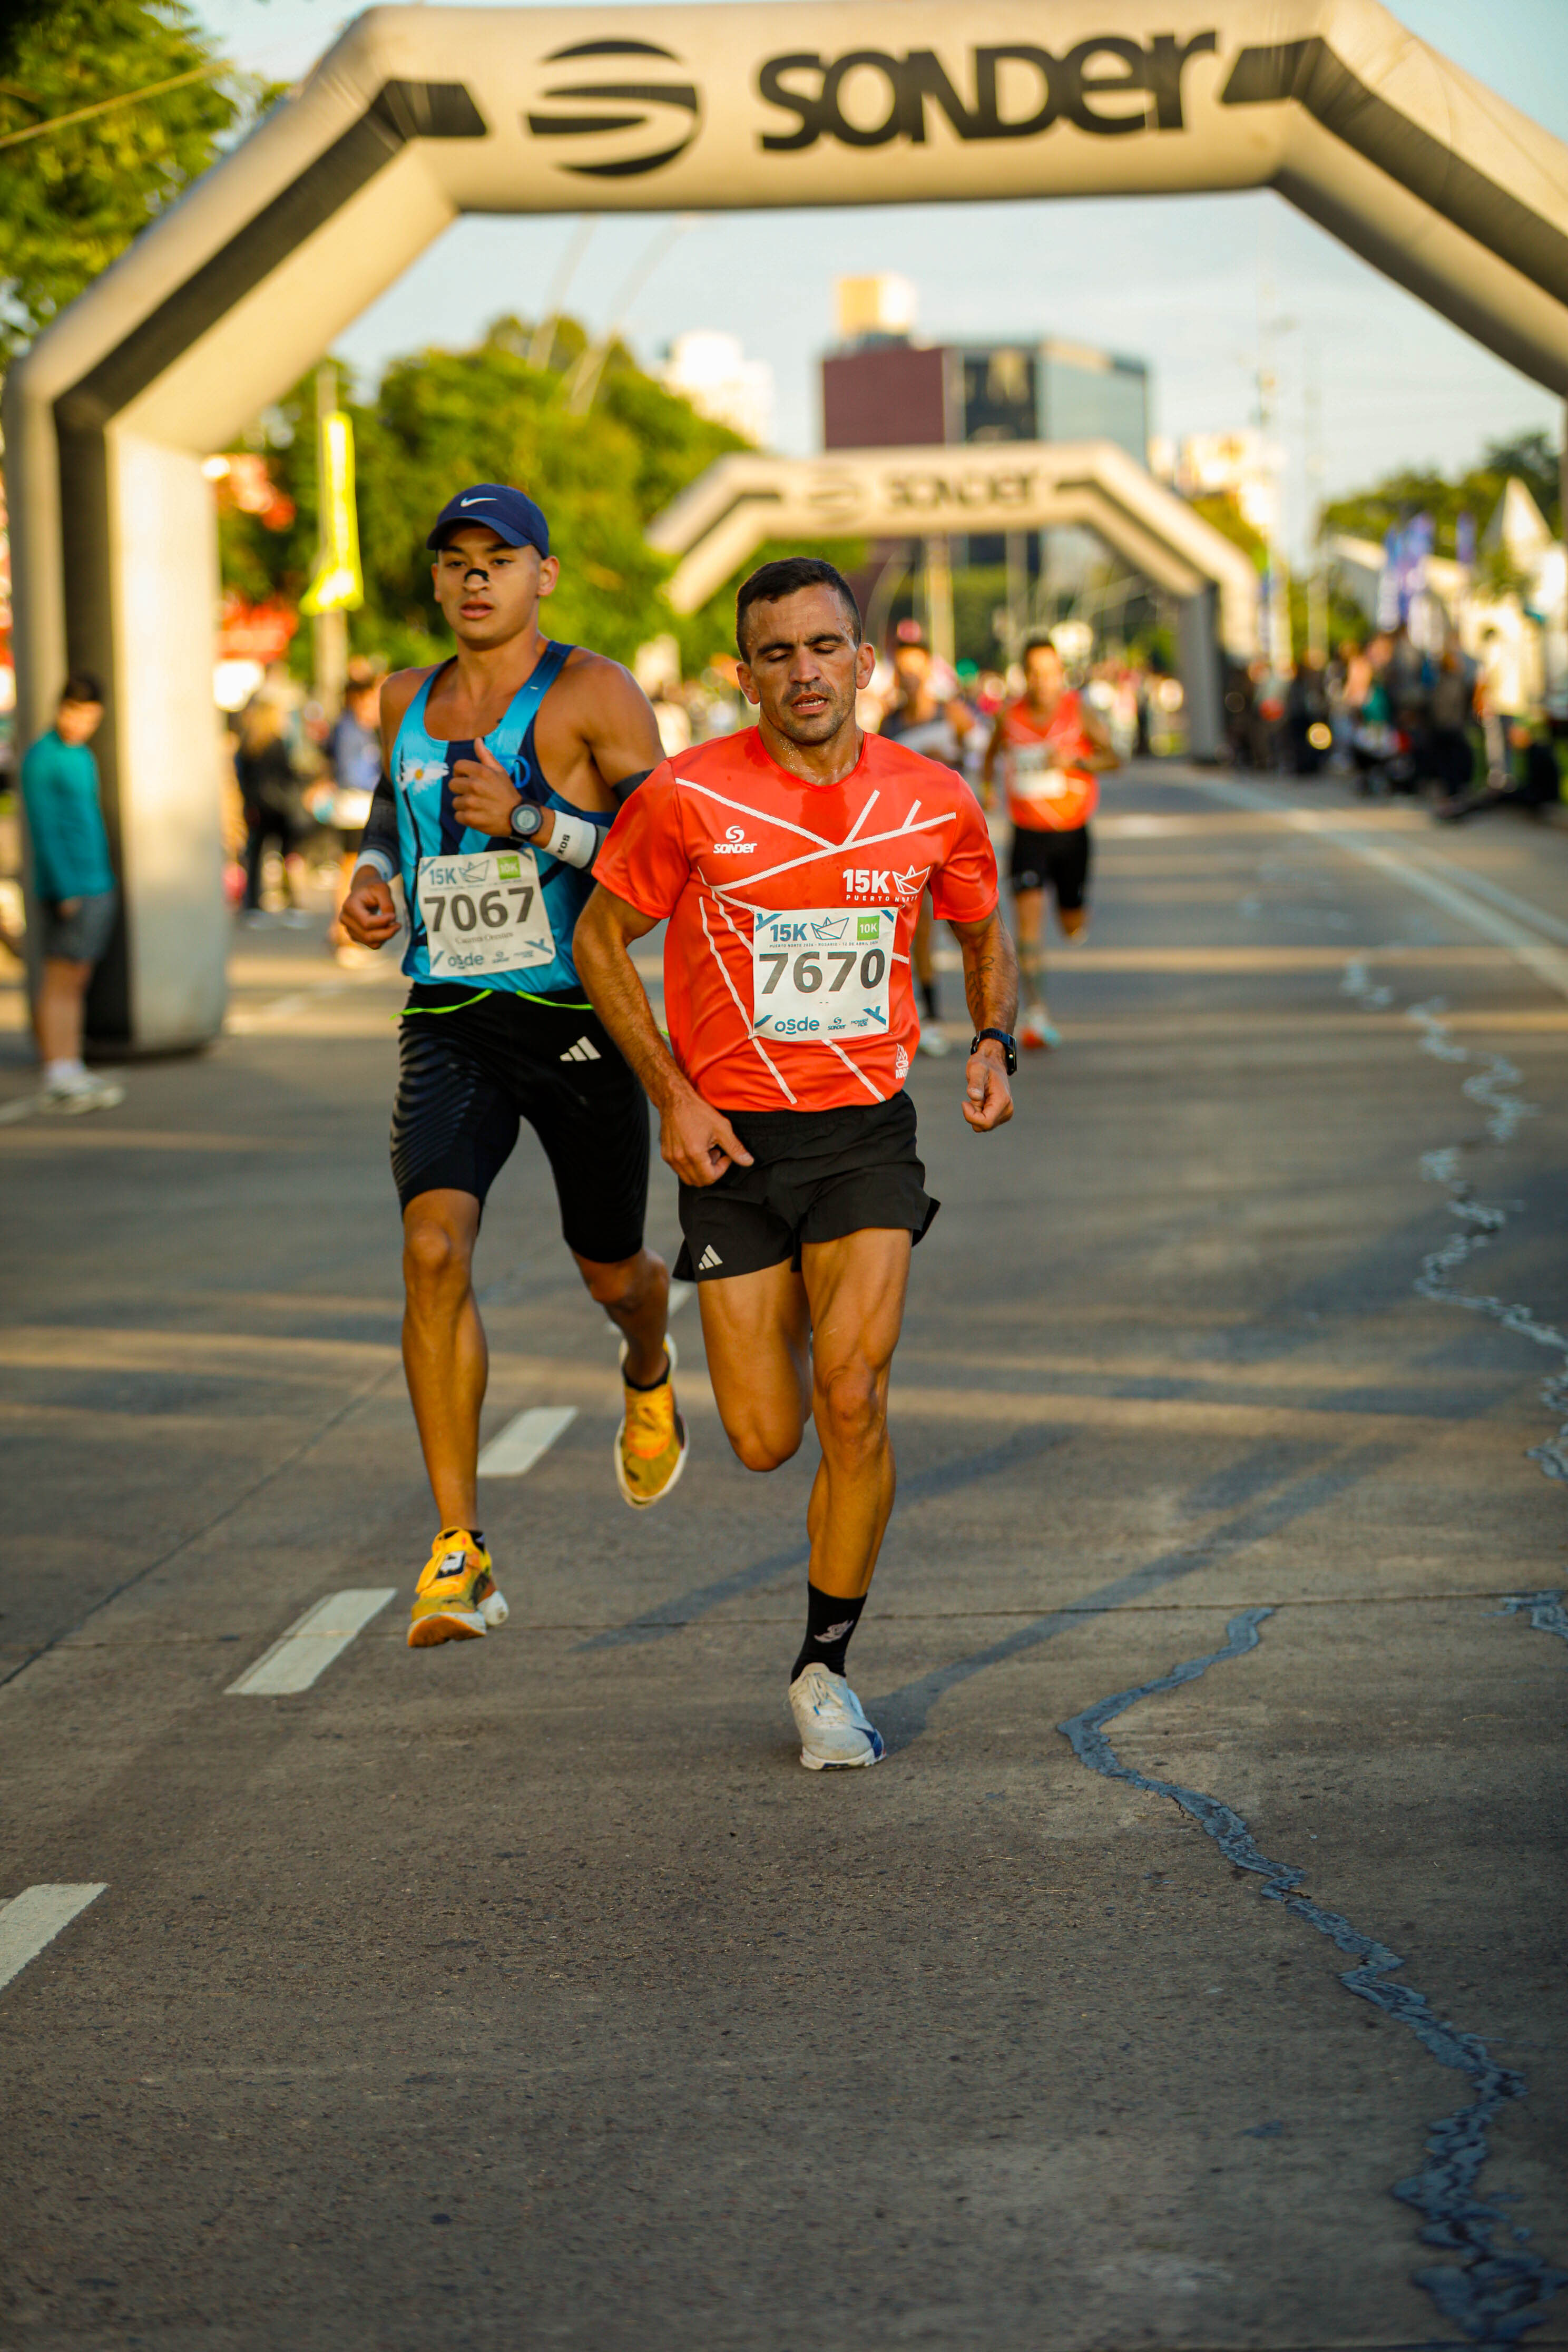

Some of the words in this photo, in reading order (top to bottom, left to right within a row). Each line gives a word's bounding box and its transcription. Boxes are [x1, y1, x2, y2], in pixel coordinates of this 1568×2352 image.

[429, 868, 457, 886] 15K
[843, 868, 890, 894] 15K
[424, 886, 534, 932] 7067
[770, 923, 808, 942] 15K
[859, 922, 878, 934] 10K
[447, 952, 484, 969] osde
[759, 948, 885, 994] 7670
[775, 1016, 820, 1034] osde
